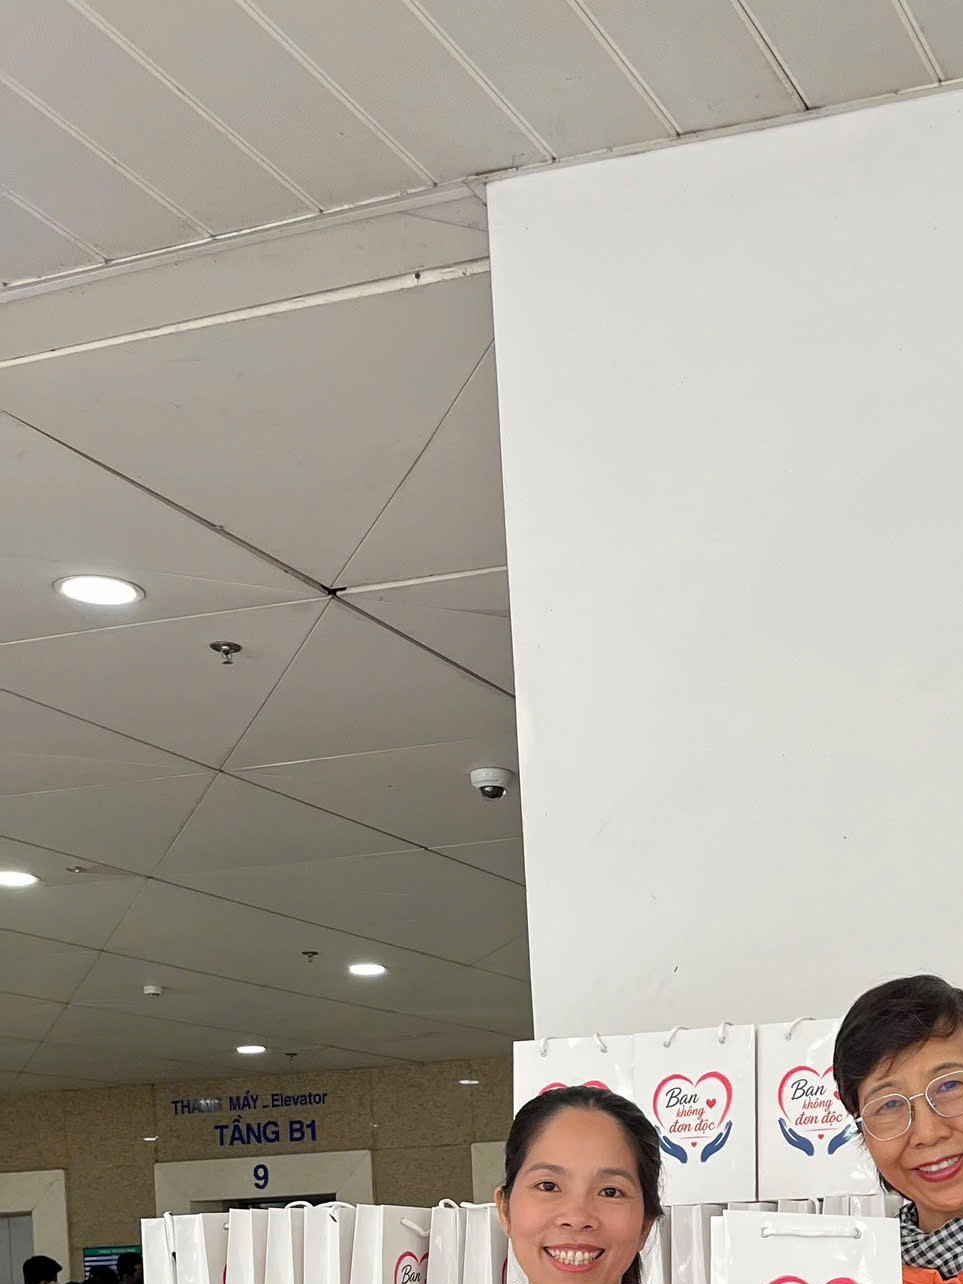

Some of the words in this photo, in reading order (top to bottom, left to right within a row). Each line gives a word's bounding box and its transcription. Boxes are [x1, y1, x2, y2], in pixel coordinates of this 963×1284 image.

[666, 1087, 699, 1108] Bạn
[791, 1079, 827, 1100] Bạn
[229, 1091, 259, 1111] MÁY
[272, 1092, 327, 1108] Elevator
[802, 1098, 833, 1112] không
[677, 1106, 704, 1120] không
[795, 1114, 819, 1126] đơn
[822, 1112, 842, 1127] độc
[215, 1115, 280, 1146] TẦNG
[289, 1120, 316, 1142] B1
[669, 1119, 692, 1133] đơn
[695, 1117, 715, 1134] độc
[254, 1164, 269, 1189] 9
